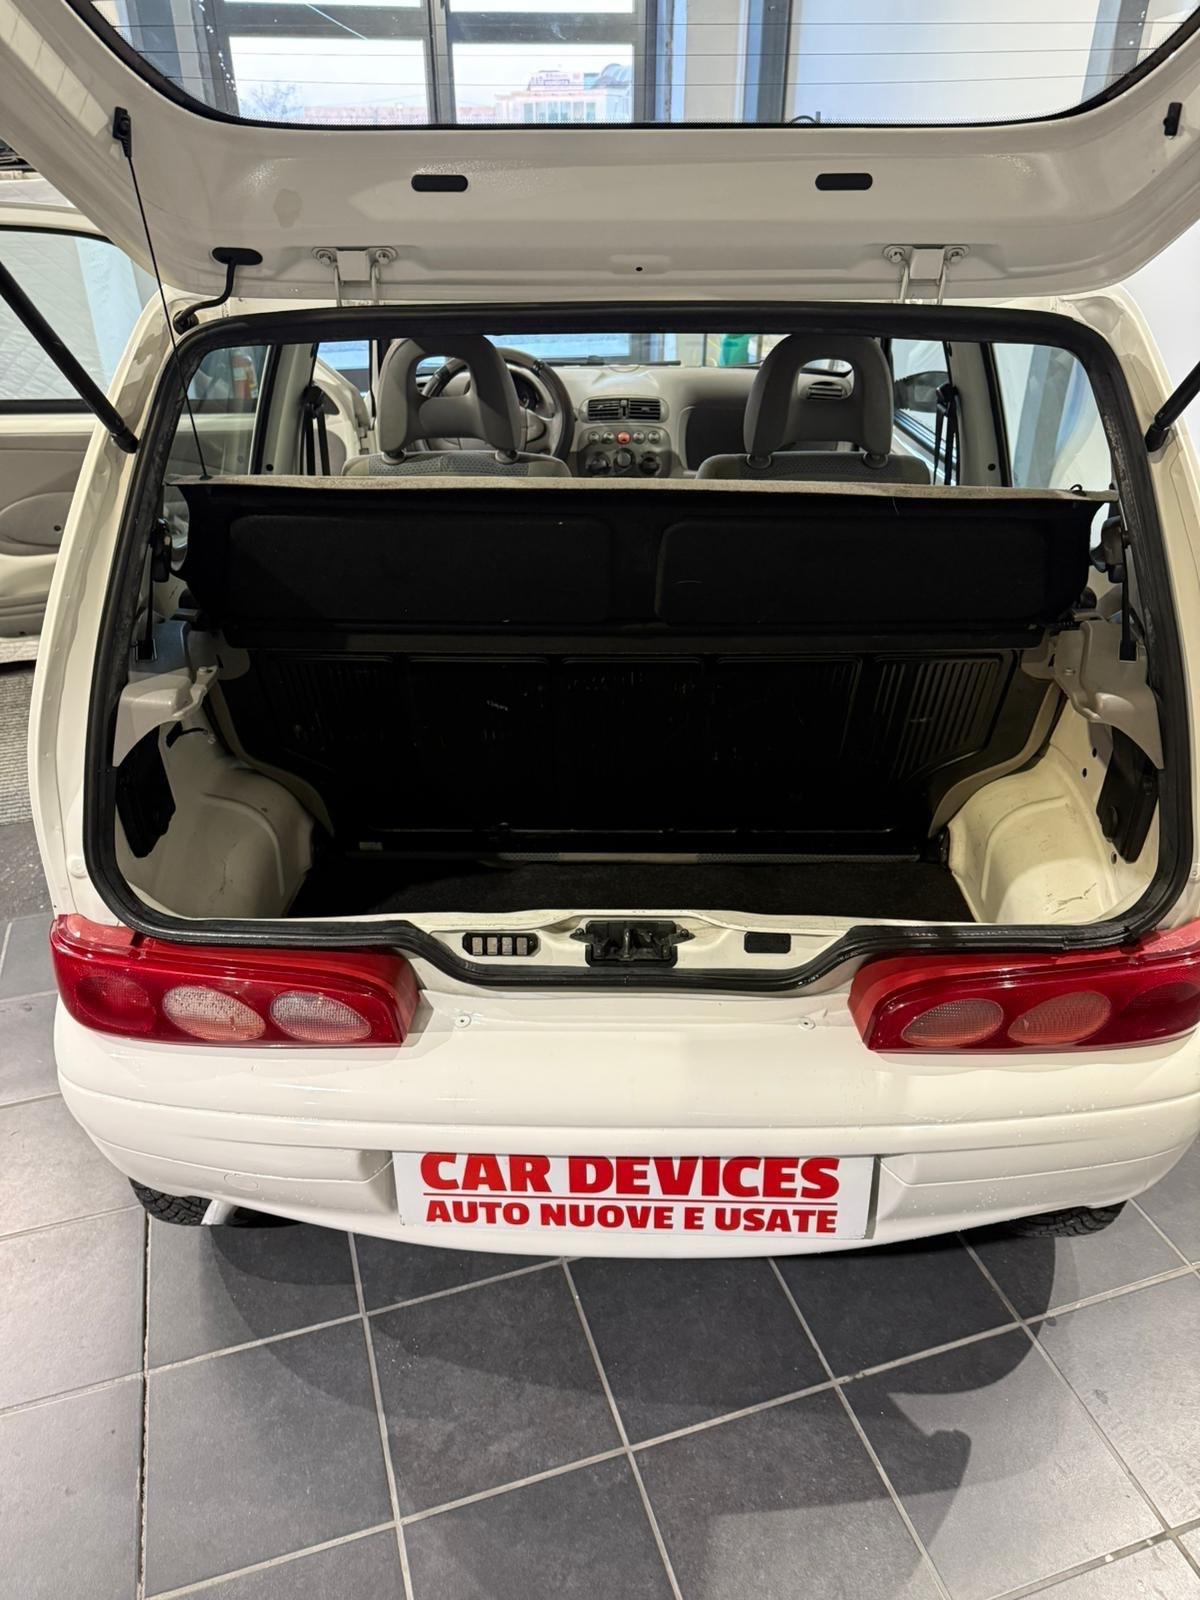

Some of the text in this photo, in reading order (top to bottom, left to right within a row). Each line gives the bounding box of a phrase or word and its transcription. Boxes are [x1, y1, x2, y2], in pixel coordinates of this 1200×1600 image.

[420, 1152, 841, 1200] CAR DEVICES
[426, 1200, 838, 1234] AUTO NUOVE E USATE
